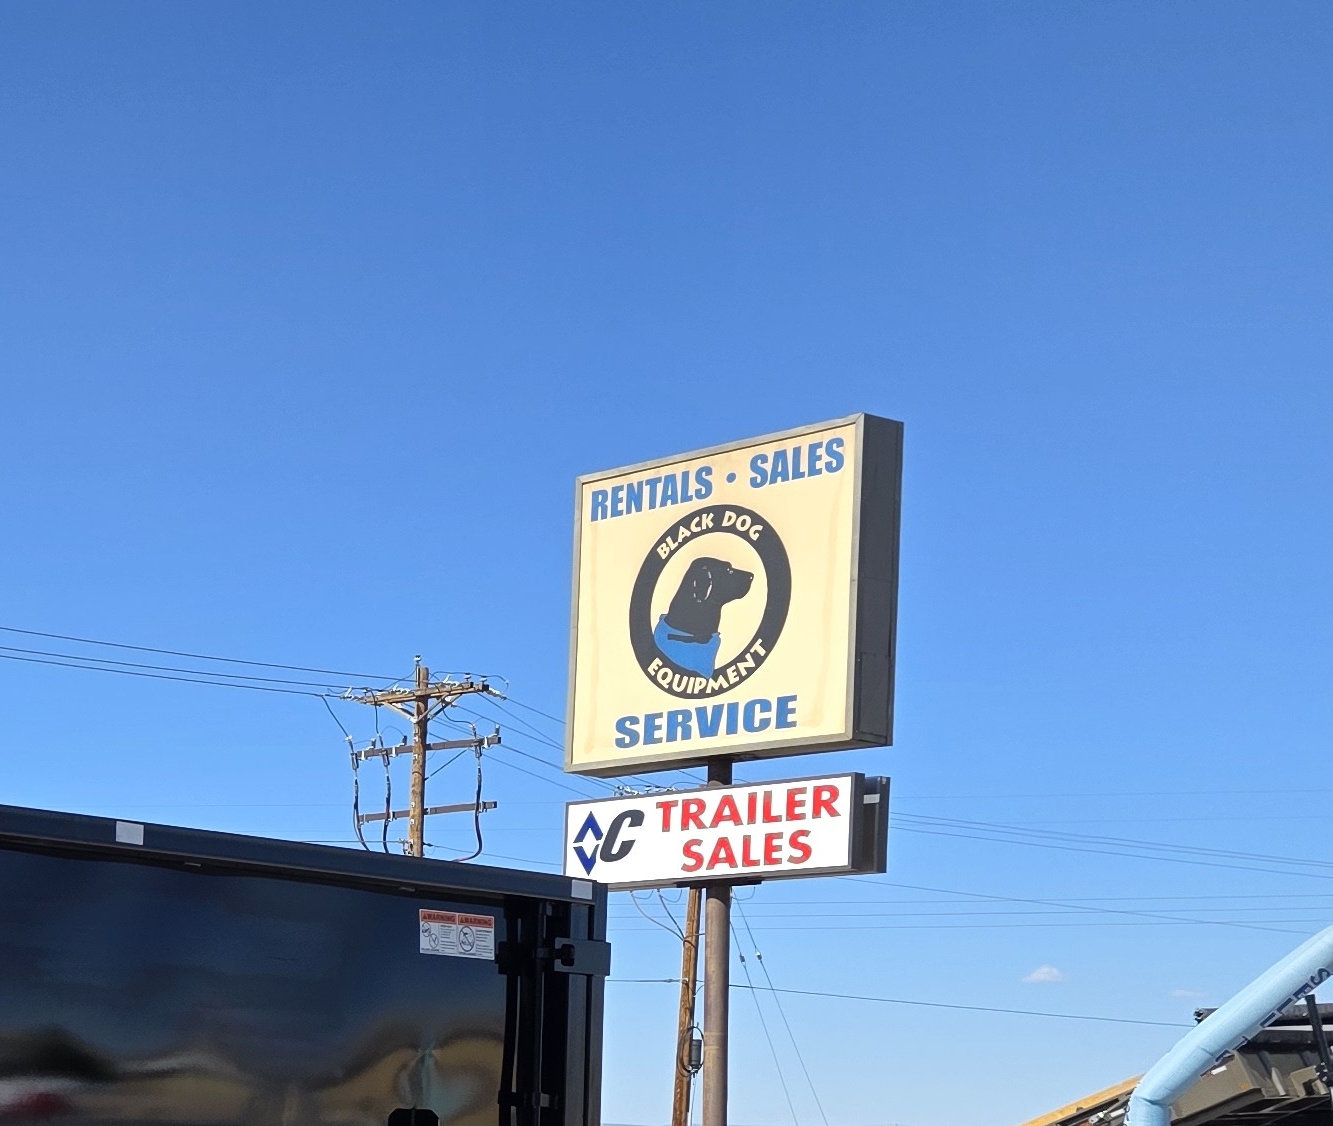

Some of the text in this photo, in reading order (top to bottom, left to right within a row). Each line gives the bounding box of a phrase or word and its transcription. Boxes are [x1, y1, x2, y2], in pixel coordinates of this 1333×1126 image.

[590, 437, 845, 522] RENTALS SALES
[656, 510, 764, 560] BLACK DOG
[647, 638, 768, 695] EQUIPMENT
[614, 694, 798, 749] SERVICE
[656, 784, 841, 833] TRAILER
[681, 829, 813, 873] SALES
